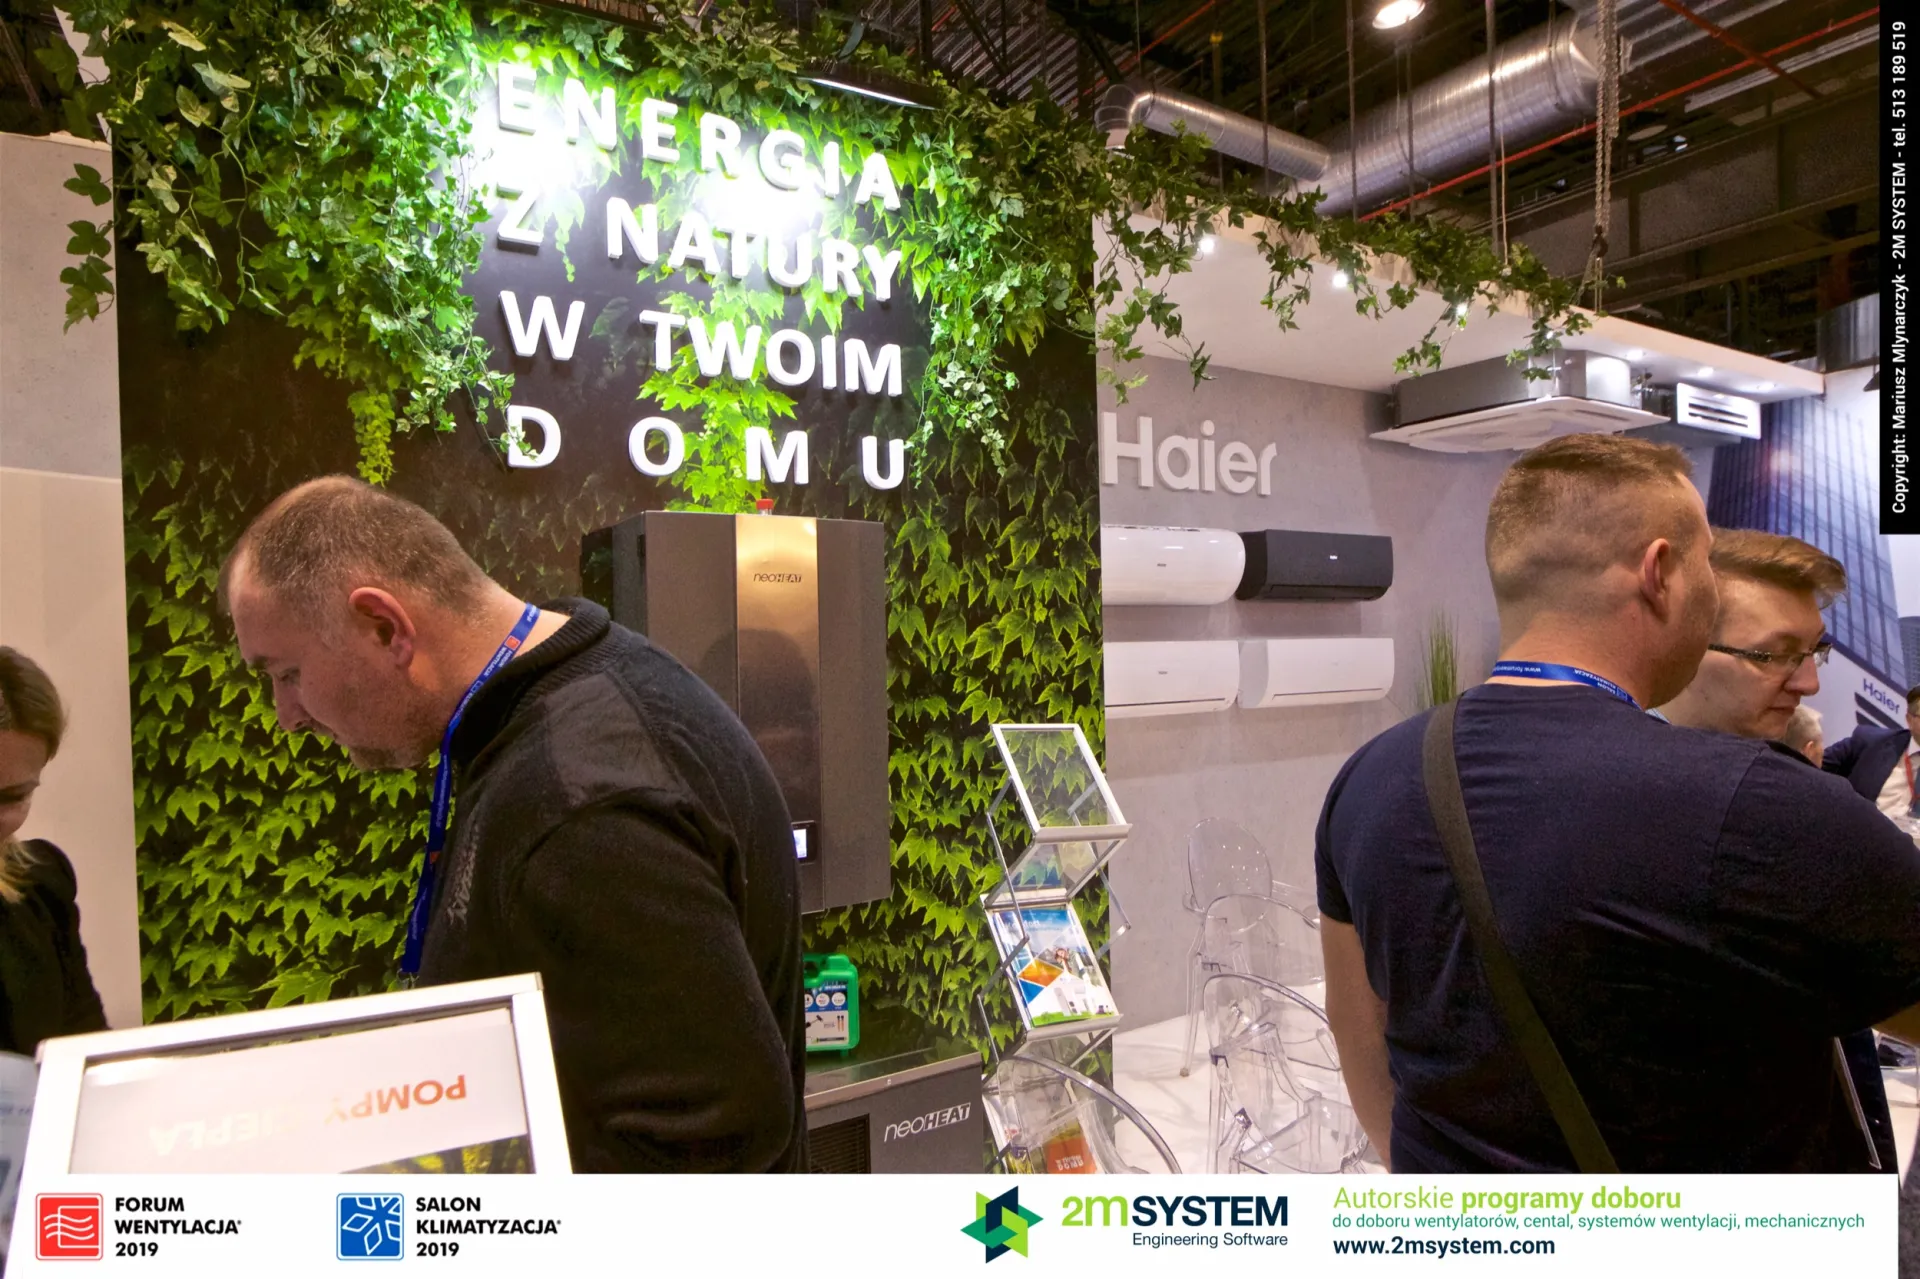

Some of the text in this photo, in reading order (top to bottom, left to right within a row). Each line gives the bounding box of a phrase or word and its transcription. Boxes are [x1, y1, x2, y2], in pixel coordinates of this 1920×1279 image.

[498, 62, 902, 211] ENERGIA
[497, 182, 902, 302] Z NATURY
[499, 290, 903, 397] W TWOIM
[506, 404, 905, 490] DOMU
[1102, 411, 1278, 496] Haier
[1863, 678, 1900, 715] Haier
[149, 1074, 467, 1156] POMPY IEPŁA
[883, 1102, 971, 1143] neoHEAT
